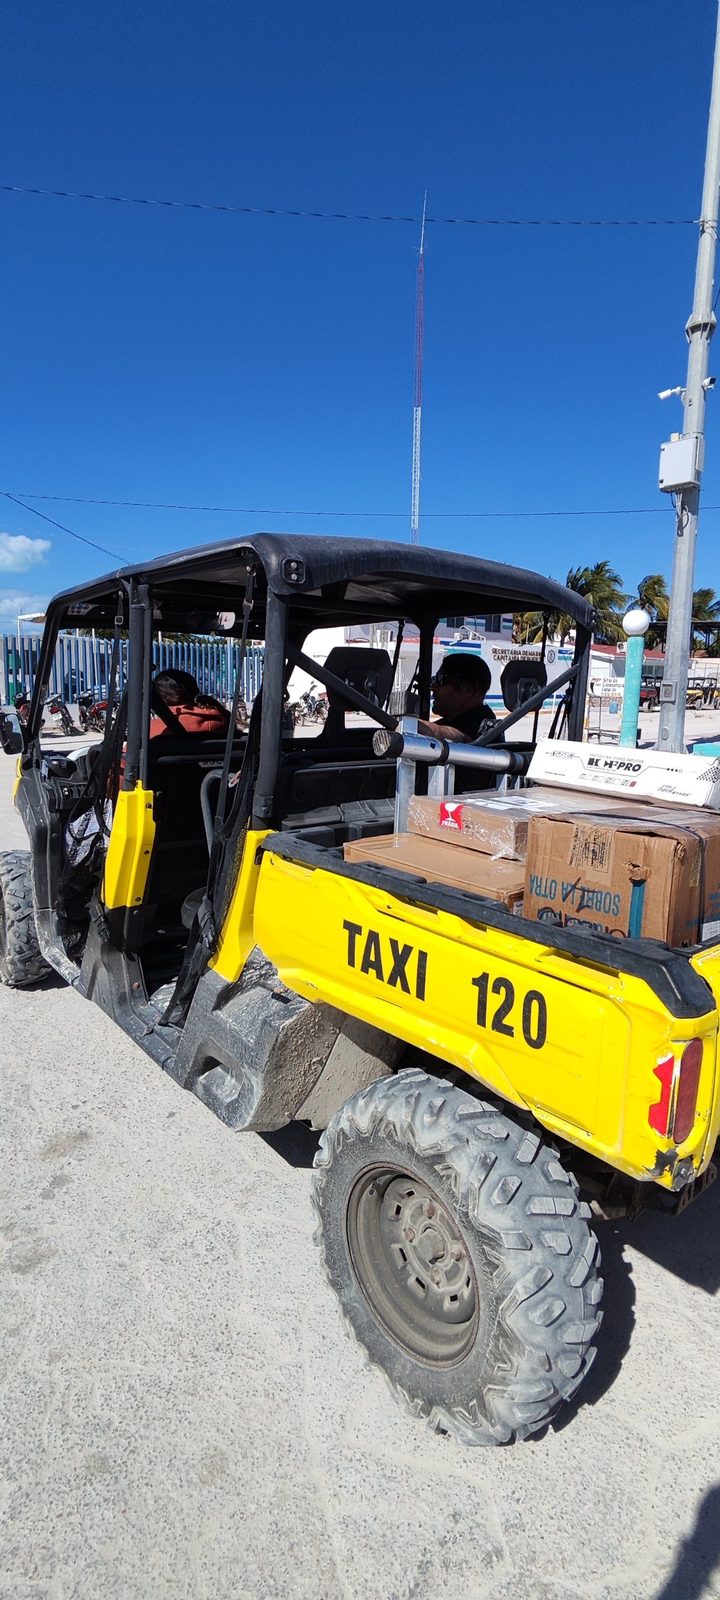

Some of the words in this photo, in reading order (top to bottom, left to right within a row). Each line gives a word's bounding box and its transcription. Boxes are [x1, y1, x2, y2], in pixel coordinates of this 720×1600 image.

[529, 874, 557, 900] OTRA
[343, 919, 428, 1002] TAXI
[472, 972, 548, 1050] 120
